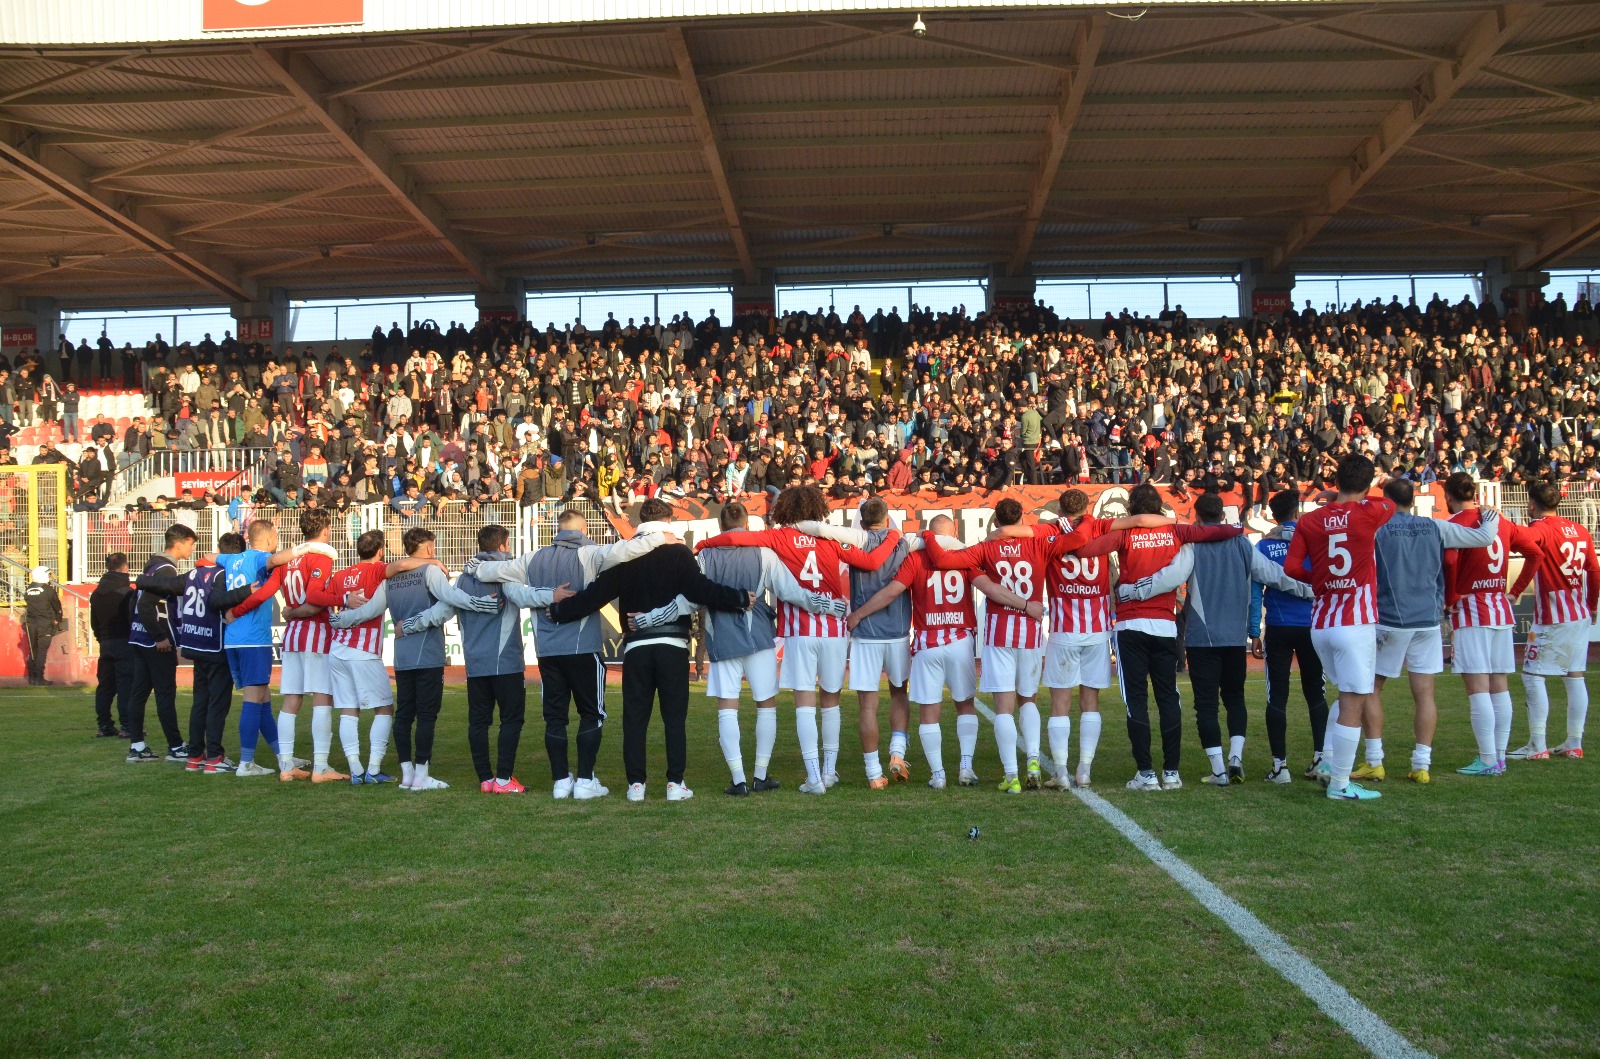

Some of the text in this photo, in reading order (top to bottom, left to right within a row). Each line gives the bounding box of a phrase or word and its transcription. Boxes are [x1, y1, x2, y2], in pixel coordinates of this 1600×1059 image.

[261, 321, 270, 333] H
[3, 333, 33, 341] H-BLOK
[1131, 532, 1149, 542] TPAO
[1266, 542, 1287, 552] TPAO
[1328, 532, 1353, 577] 5
[1487, 534, 1504, 574] 9
[1559, 541, 1587, 576] 25
[402, 571, 424, 581] BATMAN
[800, 550, 824, 588] 4
[283, 569, 307, 605] 10
[387, 578, 422, 592] PETROLSPOR
[926, 569, 965, 606] 19
[996, 560, 1034, 601] 88
[1324, 577, 1358, 590] HAMZA
[1471, 578, 1500, 590] AYKUT
[183, 585, 206, 618] 26
[925, 611, 965, 627] MUHARREM
[183, 623, 214, 638] TOPLAYICI
